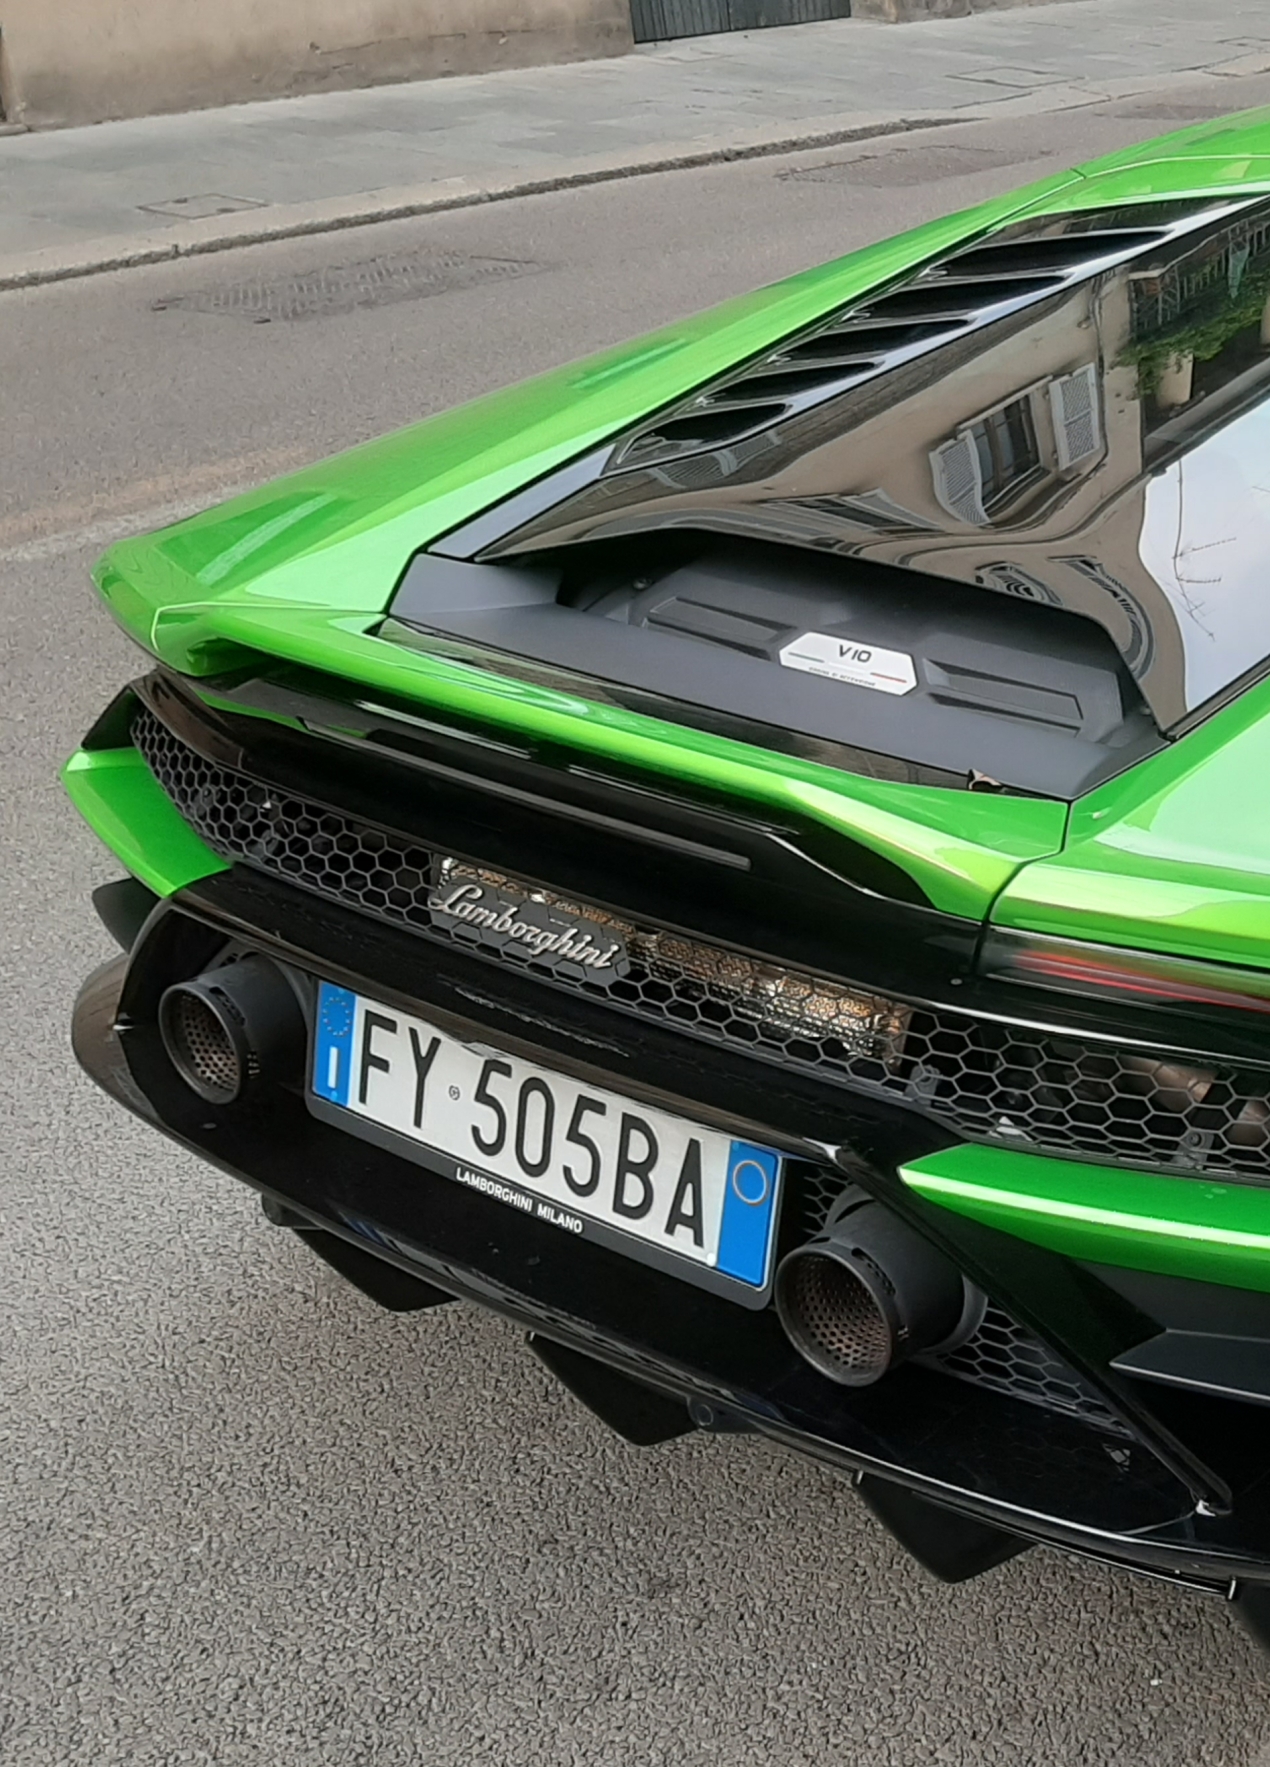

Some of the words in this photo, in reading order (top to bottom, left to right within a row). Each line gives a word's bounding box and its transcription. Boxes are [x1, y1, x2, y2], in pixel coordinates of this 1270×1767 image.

[839, 645, 872, 663] V10
[428, 885, 620, 968] Lamborghini
[358, 1009, 442, 1130] FY
[471, 1058, 705, 1249] 505BA
[456, 1167, 533, 1213] LAMBORGHINI
[537, 1203, 583, 1234] MILANO
